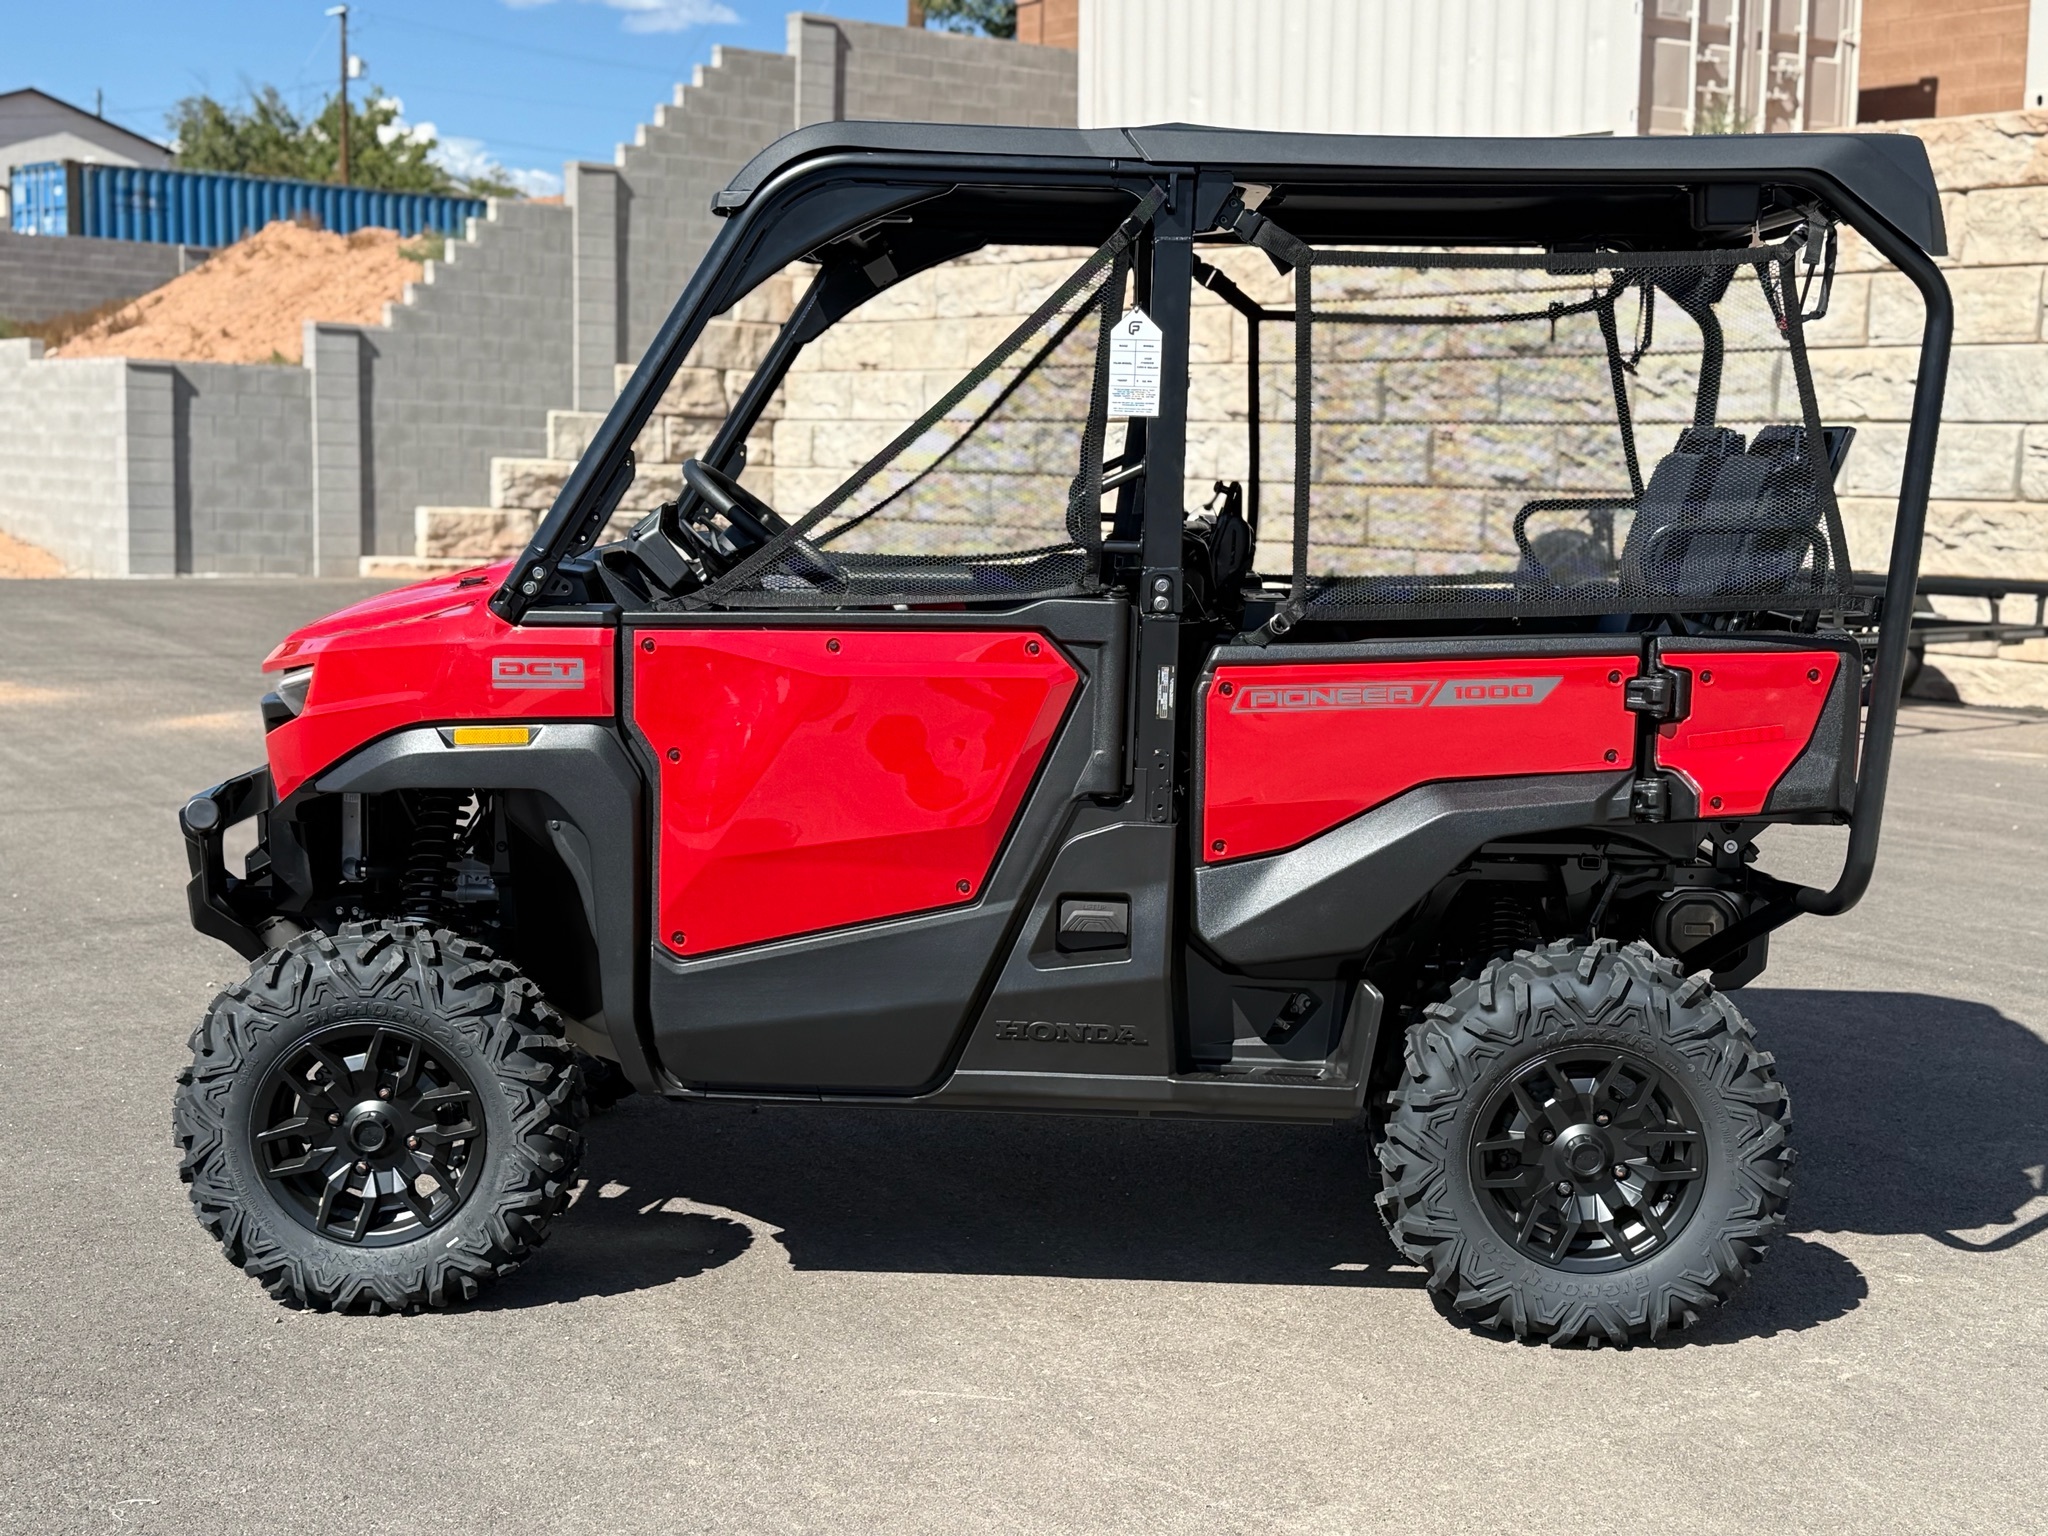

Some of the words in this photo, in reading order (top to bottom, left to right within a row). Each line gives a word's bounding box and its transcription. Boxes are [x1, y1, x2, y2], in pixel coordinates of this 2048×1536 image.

[499, 662, 578, 676] DCT
[1250, 686, 1414, 708] PIONEER
[1454, 684, 1534, 700] 1000
[302, 1002, 430, 1028] BIGHORN
[434, 1025, 473, 1058] 2.0
[996, 1020, 1149, 1046] HONDA
[1537, 1028, 1657, 1053] MAXXIS
[1478, 1238, 1516, 1271] 2.0
[1520, 1269, 1651, 1298] BIGHORN
